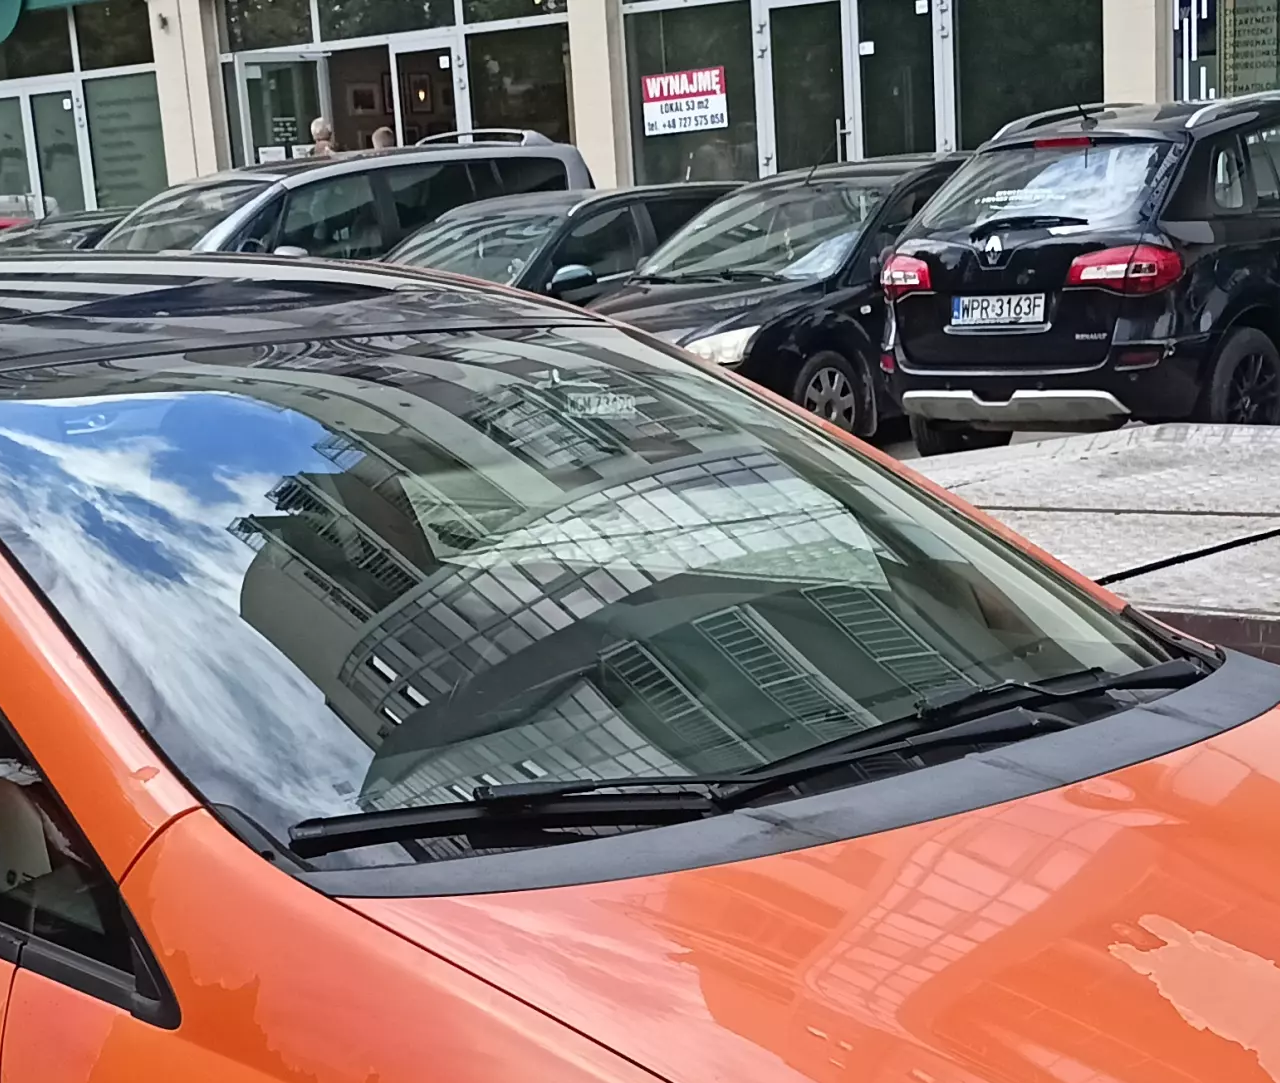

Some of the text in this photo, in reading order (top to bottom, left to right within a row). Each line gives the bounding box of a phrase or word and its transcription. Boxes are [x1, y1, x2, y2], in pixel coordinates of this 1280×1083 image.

[646, 69, 721, 98] WYNAJMĘ
[660, 102, 684, 115] LOKAL
[961, 295, 1043, 320] WPR 3163F
